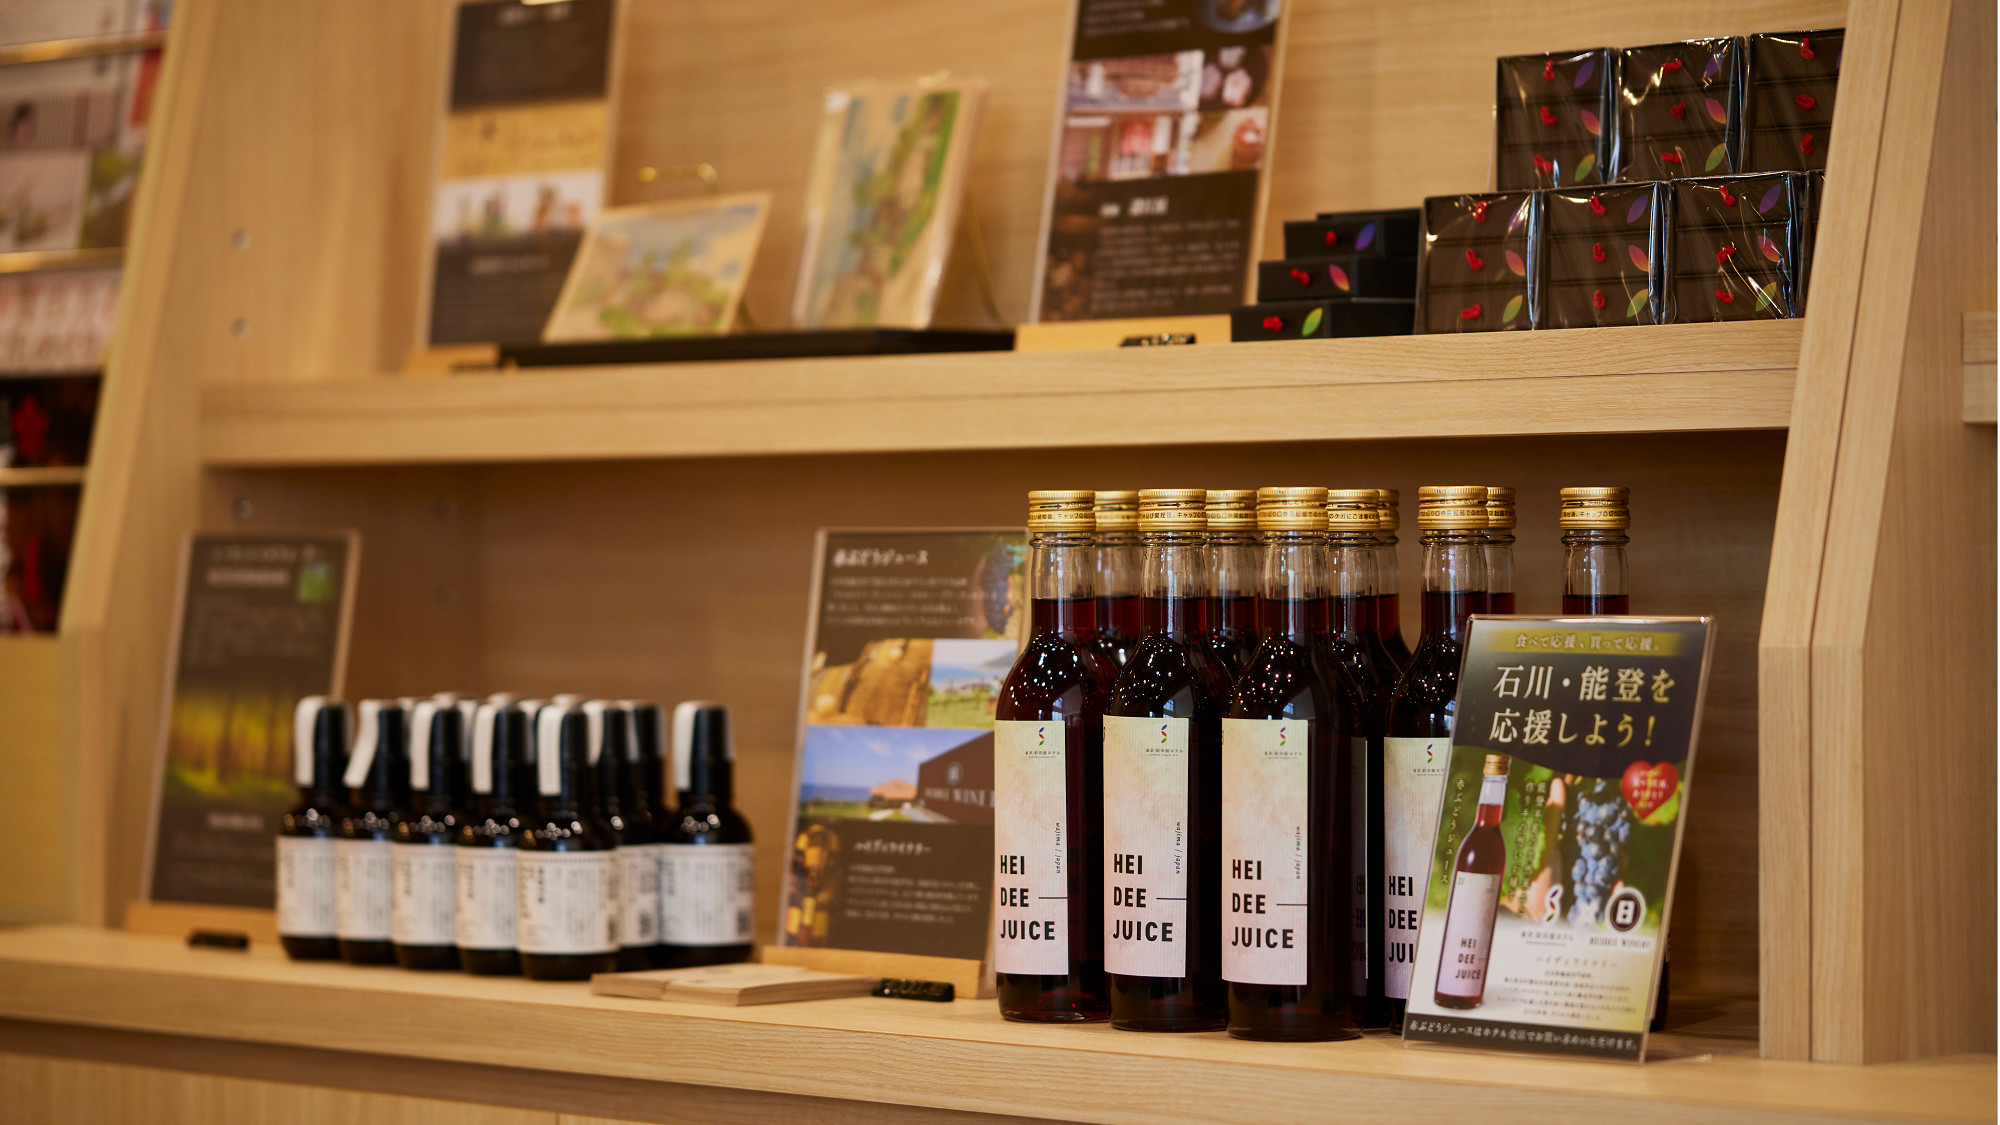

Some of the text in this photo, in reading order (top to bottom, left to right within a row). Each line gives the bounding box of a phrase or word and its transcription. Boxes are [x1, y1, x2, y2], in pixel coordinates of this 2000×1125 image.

[1515, 633, 1661, 651] 食べて応援、買って応援。
[1492, 665, 1676, 703] 石川・能登を
[1489, 708, 1656, 748] 応援しよう！
[1441, 779, 1465, 884] 赤ぶどうジュース
[1000, 854, 1025, 875] HEI
[1113, 853, 1143, 875] HEI
[1232, 859, 1262, 880] HEI
[1388, 875, 1414, 896] HEI
[1000, 887, 1030, 907] DEE
[1113, 886, 1147, 908] DEE
[1232, 892, 1266, 914] DEE
[1000, 919, 1056, 940] JUICE
[1388, 909, 1418, 930] DEE
[1112, 919, 1174, 942] JUICE
[1231, 926, 1294, 949] JUICE
[1460, 938, 1477, 948] HEI
[1458, 953, 1476, 963] DEE
[1455, 969, 1481, 979] JUICE
